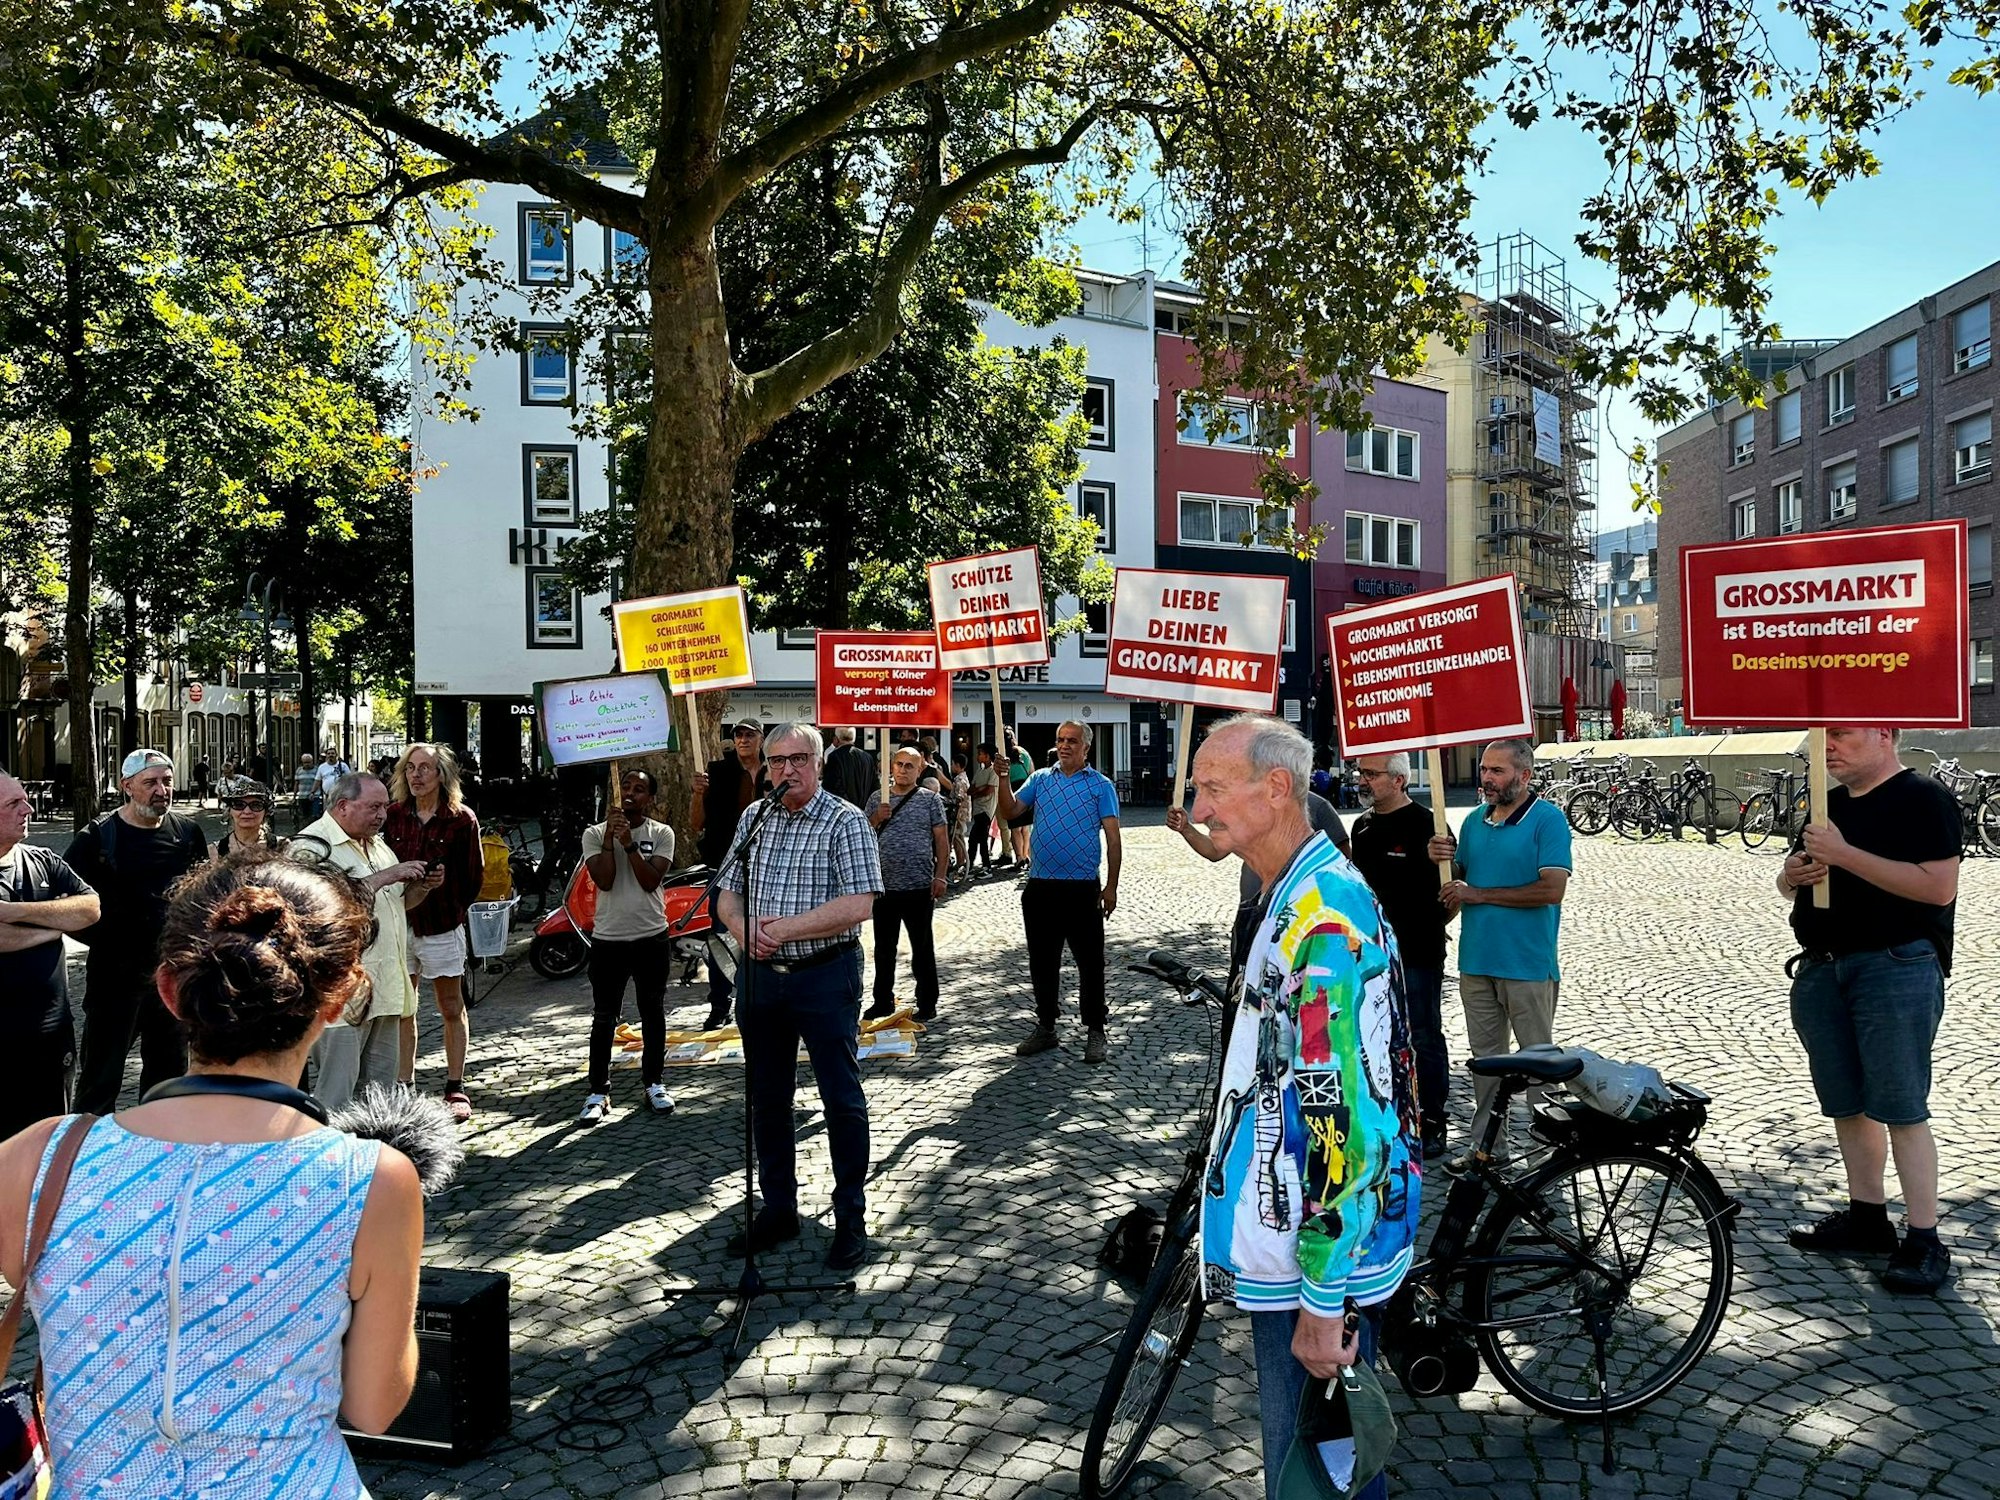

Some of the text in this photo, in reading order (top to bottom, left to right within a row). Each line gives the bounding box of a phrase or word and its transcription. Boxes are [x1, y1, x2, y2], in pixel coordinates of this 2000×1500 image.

[951, 564, 1013, 590] SCHÜTZE
[1161, 588, 1221, 612] LIEBE
[1723, 573, 1917, 608] GROSSMARKT
[960, 592, 1010, 615] DEINEN
[652, 607, 703, 623] GROßMARKT
[1348, 604, 1479, 645] GROßMARKT VERSORGT
[656, 622, 705, 637] SCHLIEßUNG
[946, 616, 1036, 643] GROßMARKT
[1148, 619, 1227, 646] DEINEN
[1723, 614, 1920, 640] ist Bestandteil der
[645, 634, 721, 654] 160 UNTERNEHMEN
[1350, 634, 1444, 666] WOCHENMÄRKTE
[667, 648, 729, 666] ARBEITSPLÄTZE
[838, 649, 933, 663] GROSSMARKT
[1117, 648, 1263, 683] GROßMARKT
[1352, 645, 1512, 687] LEBENSMITTELEINZELHANDEL
[1732, 651, 1910, 672] Daseinsvorsorge
[674, 668, 691, 679] DER
[693, 664, 717, 676] KIPPE
[844, 669, 926, 681] versorgt Kölner
[835, 685, 936, 698] Bürger mit (frische)
[1355, 682, 1433, 708] GASTRONOMIE
[511, 705, 535, 714] DAS
[853, 702, 918, 713] Lebensmittel
[1357, 708, 1411, 730] KANTINEN
